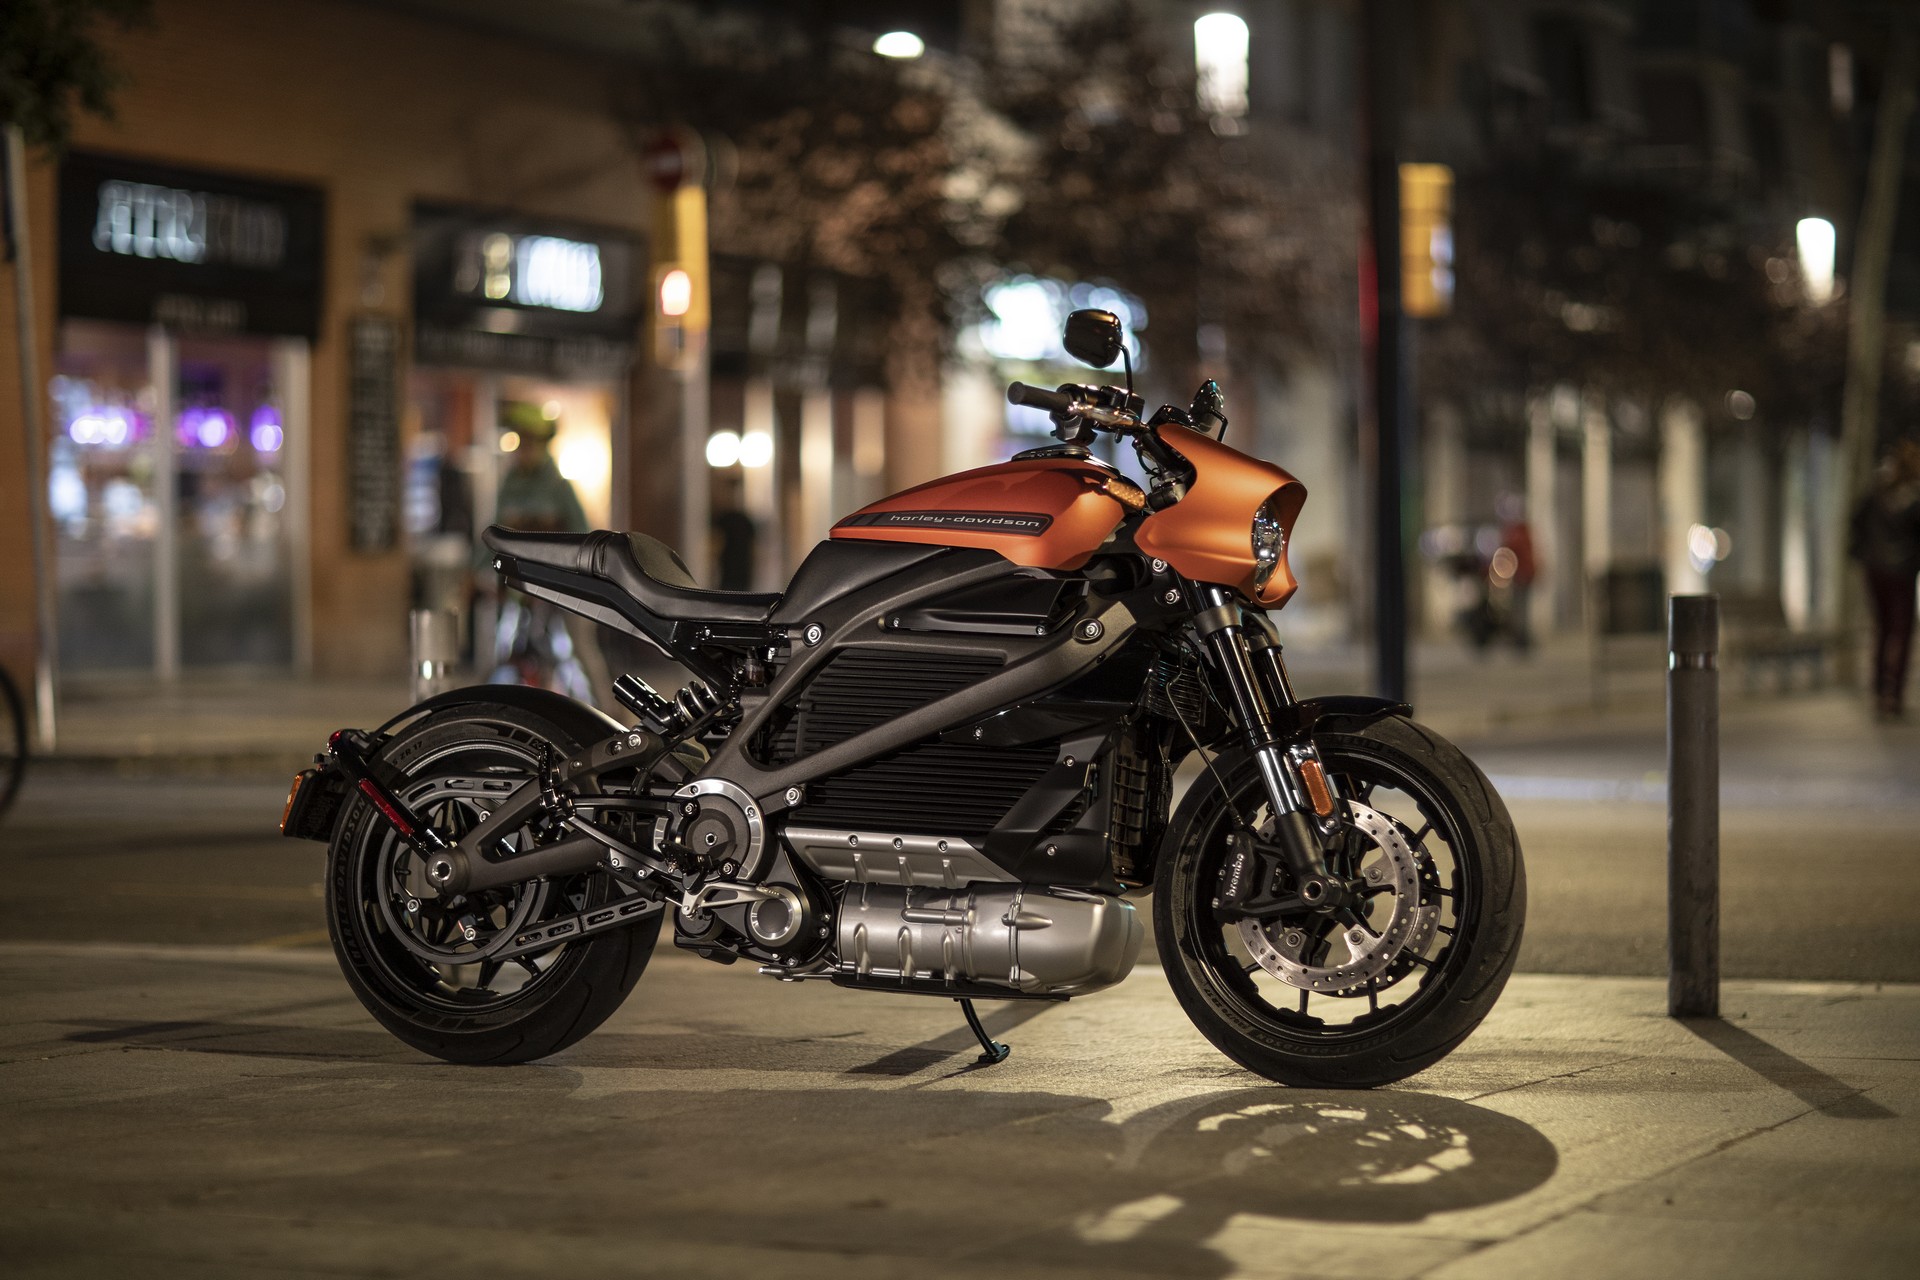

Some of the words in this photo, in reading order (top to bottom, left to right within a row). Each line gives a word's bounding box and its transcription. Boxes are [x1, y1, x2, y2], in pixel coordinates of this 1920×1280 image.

[889, 514, 1040, 528] harley-davidson
[336, 796, 367, 960] HARLEY-DAVIDSON
[1226, 853, 1245, 897] brembo
